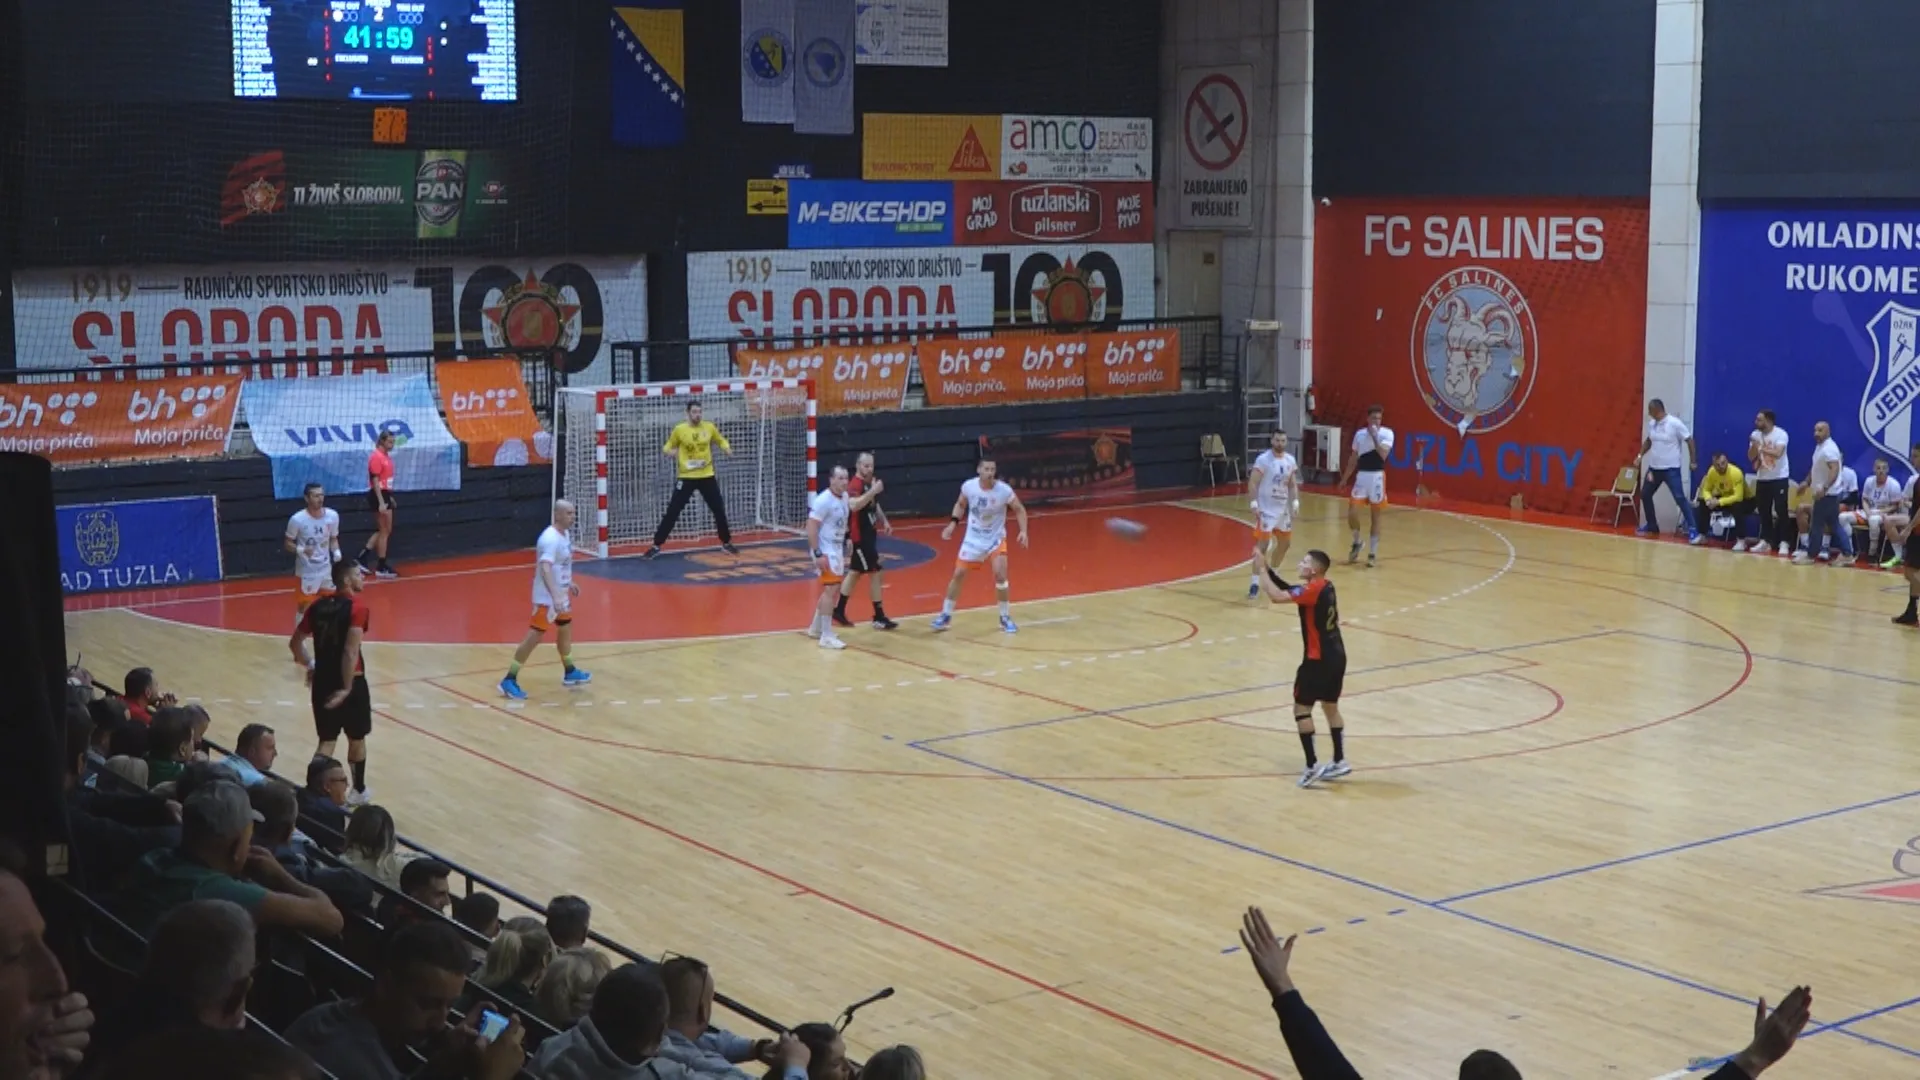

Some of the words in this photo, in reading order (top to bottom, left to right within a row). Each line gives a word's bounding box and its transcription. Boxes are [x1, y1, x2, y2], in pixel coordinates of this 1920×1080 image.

[344, 25, 413, 50] 41:59
[1010, 119, 1096, 150] amco
[294, 187, 306, 204] TI
[307, 183, 341, 204] ŽIVIŠ
[417, 182, 463, 199] PAN
[1183, 179, 1248, 195] ZABRANJENO
[797, 201, 946, 224] M-BIKESHOP
[972, 195, 992, 211] MOJ
[1021, 188, 1090, 213] tuzlanski
[1117, 194, 1141, 211] MOJE
[966, 213, 998, 230] GRAD
[1034, 217, 1077, 235] pilsner
[1118, 212, 1140, 230] PIVO
[1364, 215, 1411, 256] FC
[1423, 216, 1604, 261] SALINES
[1767, 220, 1920, 250] OMLADIN
[810, 255, 862, 280] RADNIČKO
[863, 259, 915, 279] SPORTSKO
[918, 253, 962, 278] DRUŠTVO
[1786, 263, 1920, 294] RUKOME
[184, 271, 253, 300] RADNIČKO
[256, 273, 326, 299] SPORTSKO
[329, 269, 388, 295] DRUŠTVO
[1425, 286, 1445, 311] FC
[1449, 271, 1525, 316] SALINES
[938, 348, 971, 375] bh
[1021, 345, 1055, 371] bh
[1104, 340, 1134, 366] bh
[833, 354, 869, 381] bh
[1108, 371, 1137, 388] Moja
[943, 380, 972, 398] Moja
[1027, 376, 1055, 392] Moja
[128, 388, 178, 422] bh
[452, 391, 485, 412] bh
[0, 435, 45, 454] Moja
[134, 425, 178, 448] Moja
[1388, 432, 1485, 482] UZLA
[1497, 441, 1584, 490] CITY
[60, 570, 92, 591] AD
[98, 563, 181, 588] TUZLA
